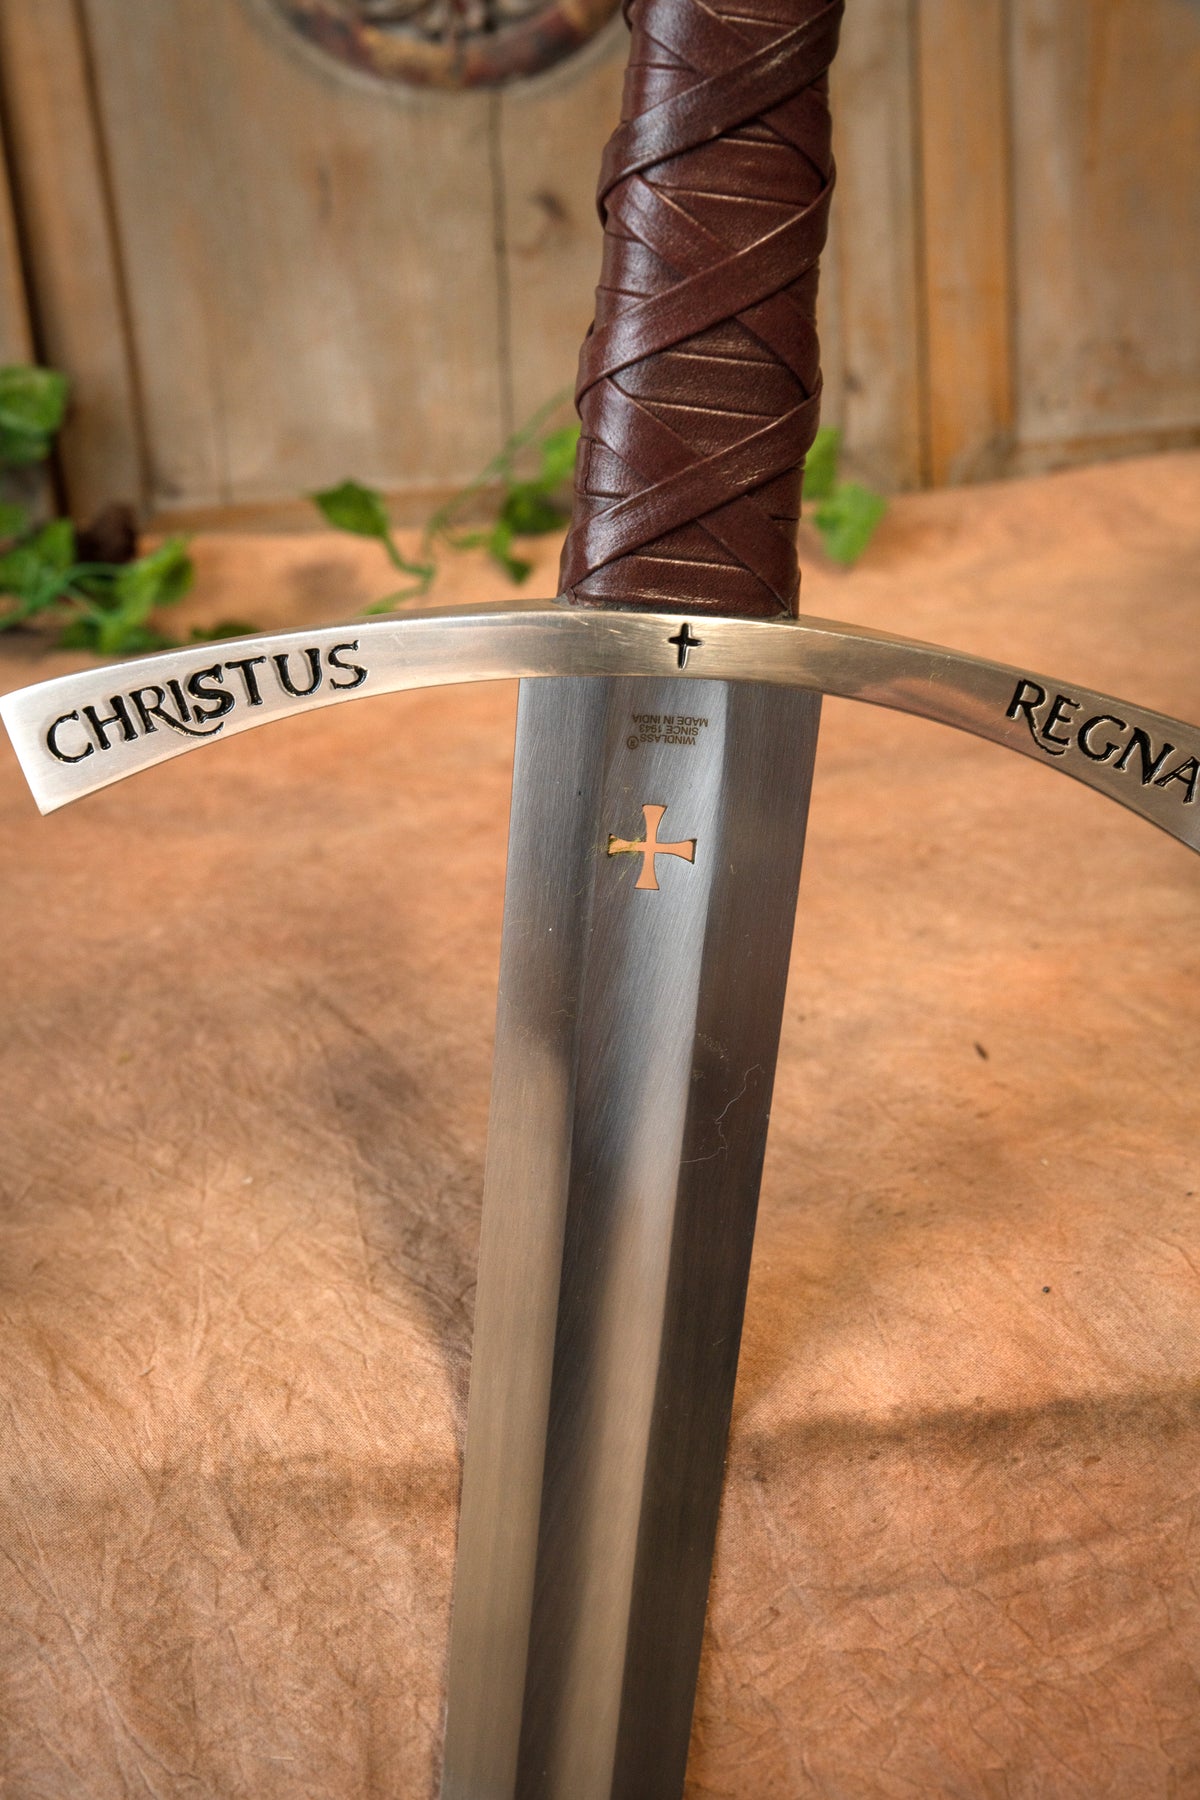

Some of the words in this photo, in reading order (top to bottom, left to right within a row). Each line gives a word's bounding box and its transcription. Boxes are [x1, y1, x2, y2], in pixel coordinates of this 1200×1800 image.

[46, 640, 370, 764] CHRISTUS
[632, 714, 660, 724] INDIA
[663, 715, 675, 724] IN
[677, 716, 709, 728] MADE
[639, 723, 661, 734] 1943
[666, 725, 699, 736] SINCE
[1005, 678, 1200, 805] REGNA
